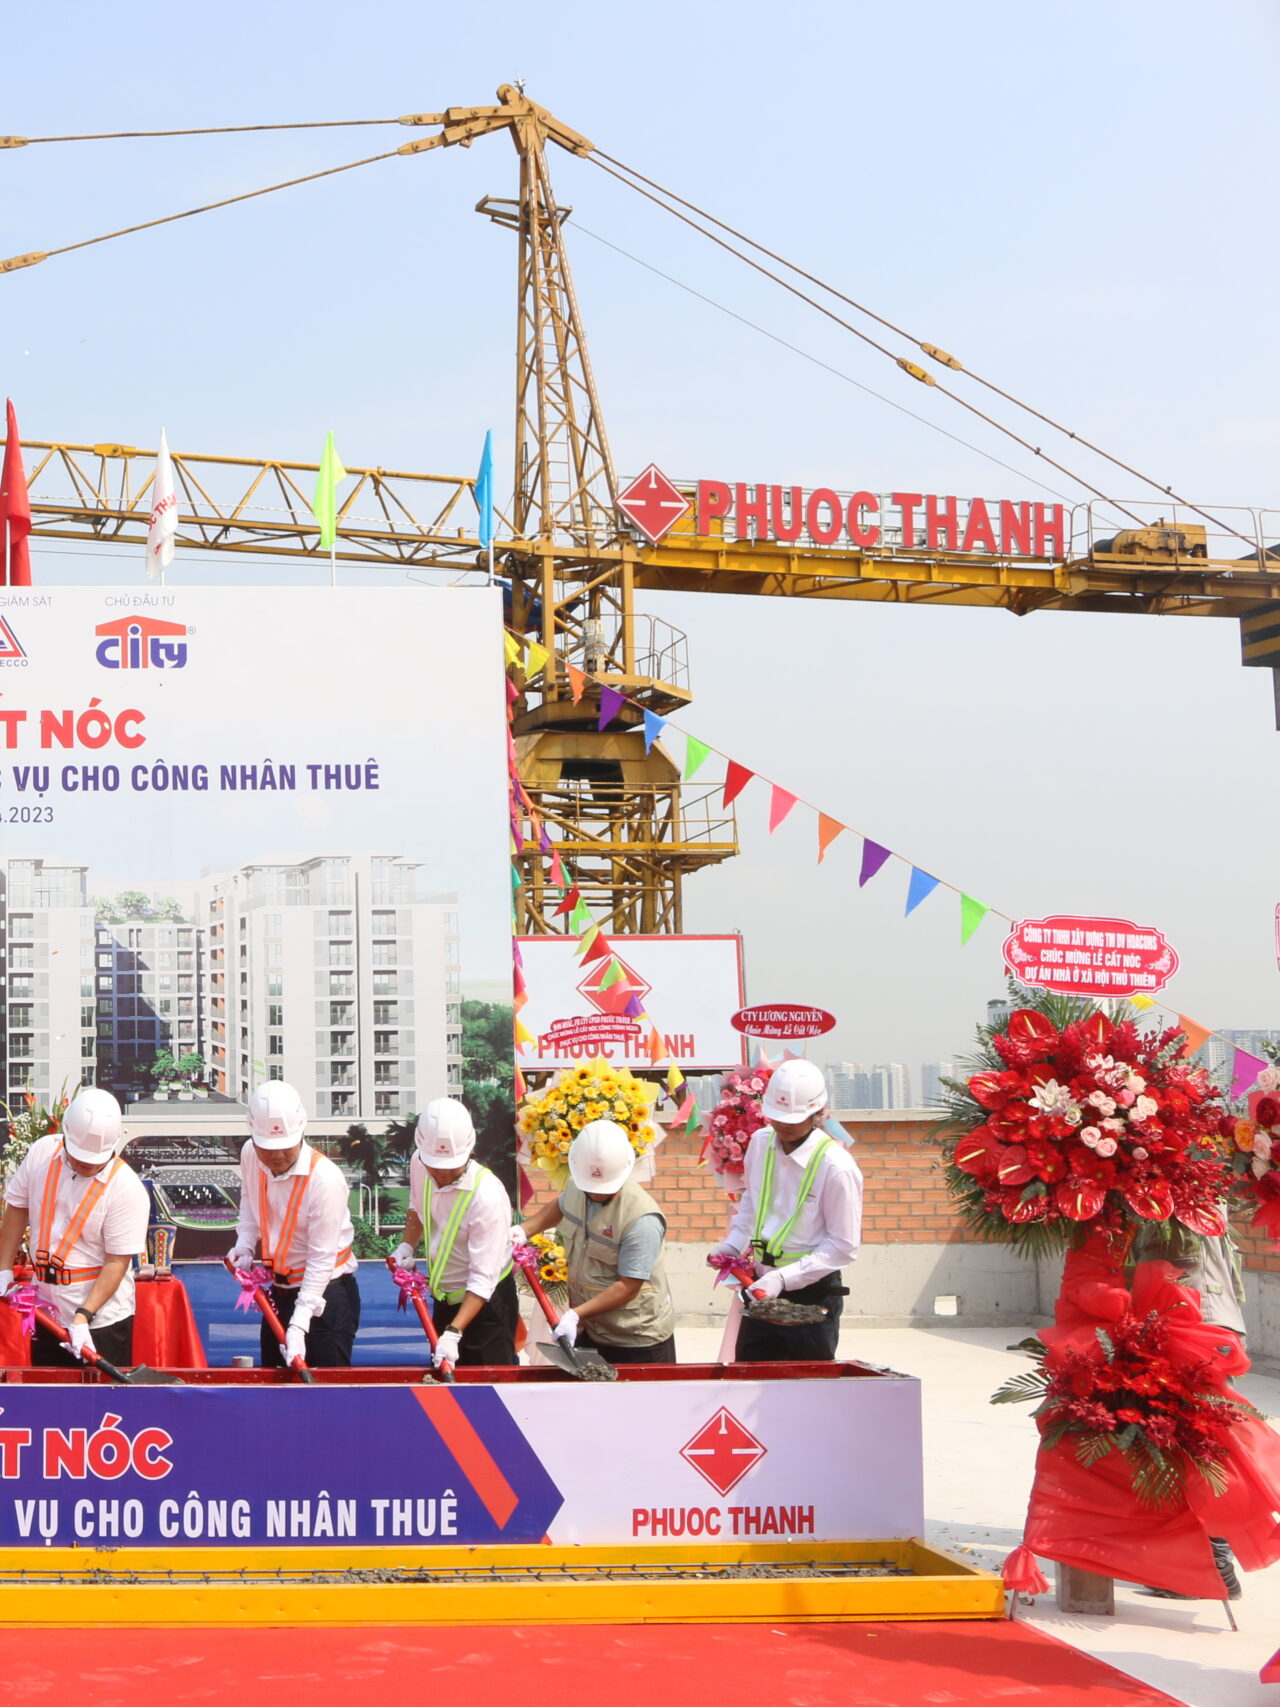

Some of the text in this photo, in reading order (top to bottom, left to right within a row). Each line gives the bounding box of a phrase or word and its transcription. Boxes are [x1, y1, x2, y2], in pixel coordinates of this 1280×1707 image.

[698, 480, 1064, 558] PHUOC THANH
[33, 596, 52, 607] SÁT
[105, 594, 130, 607] CHỦ
[161, 596, 176, 607] TƯ
[41, 697, 147, 750] NÓC
[12, 765, 50, 797] VỤ
[61, 765, 120, 792] CHO
[131, 759, 209, 792] CÔNG
[220, 758, 296, 791] NHÂN
[307, 757, 380, 791] THUÊ
[1023, 925, 1043, 943] CÔNG
[1043, 929, 1052, 943] TY
[1052, 929, 1070, 945] TNHH
[1071, 928, 1085, 945] XÂY
[1086, 930, 1104, 950] DỰNG
[1105, 933, 1116, 947] TM
[1040, 948, 1141, 968] CHÚC MỪNG LỄ CẤT NÓC
[1025, 966, 1038, 983] DỰ
[1038, 966, 1051, 980] ÁN
[1053, 967, 1071, 982] NHÀ
[1073, 965, 1081, 982] Ở
[1081, 967, 1094, 983] XÃ
[1095, 969, 1110, 987] HỘI
[1129, 970, 1156, 987] THIÊM
[741, 1011, 759, 1022] CTY
[759, 1009, 787, 1022] LƯƠNG
[623, 1034, 695, 1058] THNH
[43, 1412, 174, 1480] NÓC
[18, 1499, 59, 1546] VỤ
[74, 1499, 144, 1537] CHO
[159, 1490, 251, 1538] CÔNG
[266, 1490, 357, 1538] NHÂN
[371, 1488, 458, 1537] THUÊ
[632, 1505, 815, 1537] PHUOC THANH
